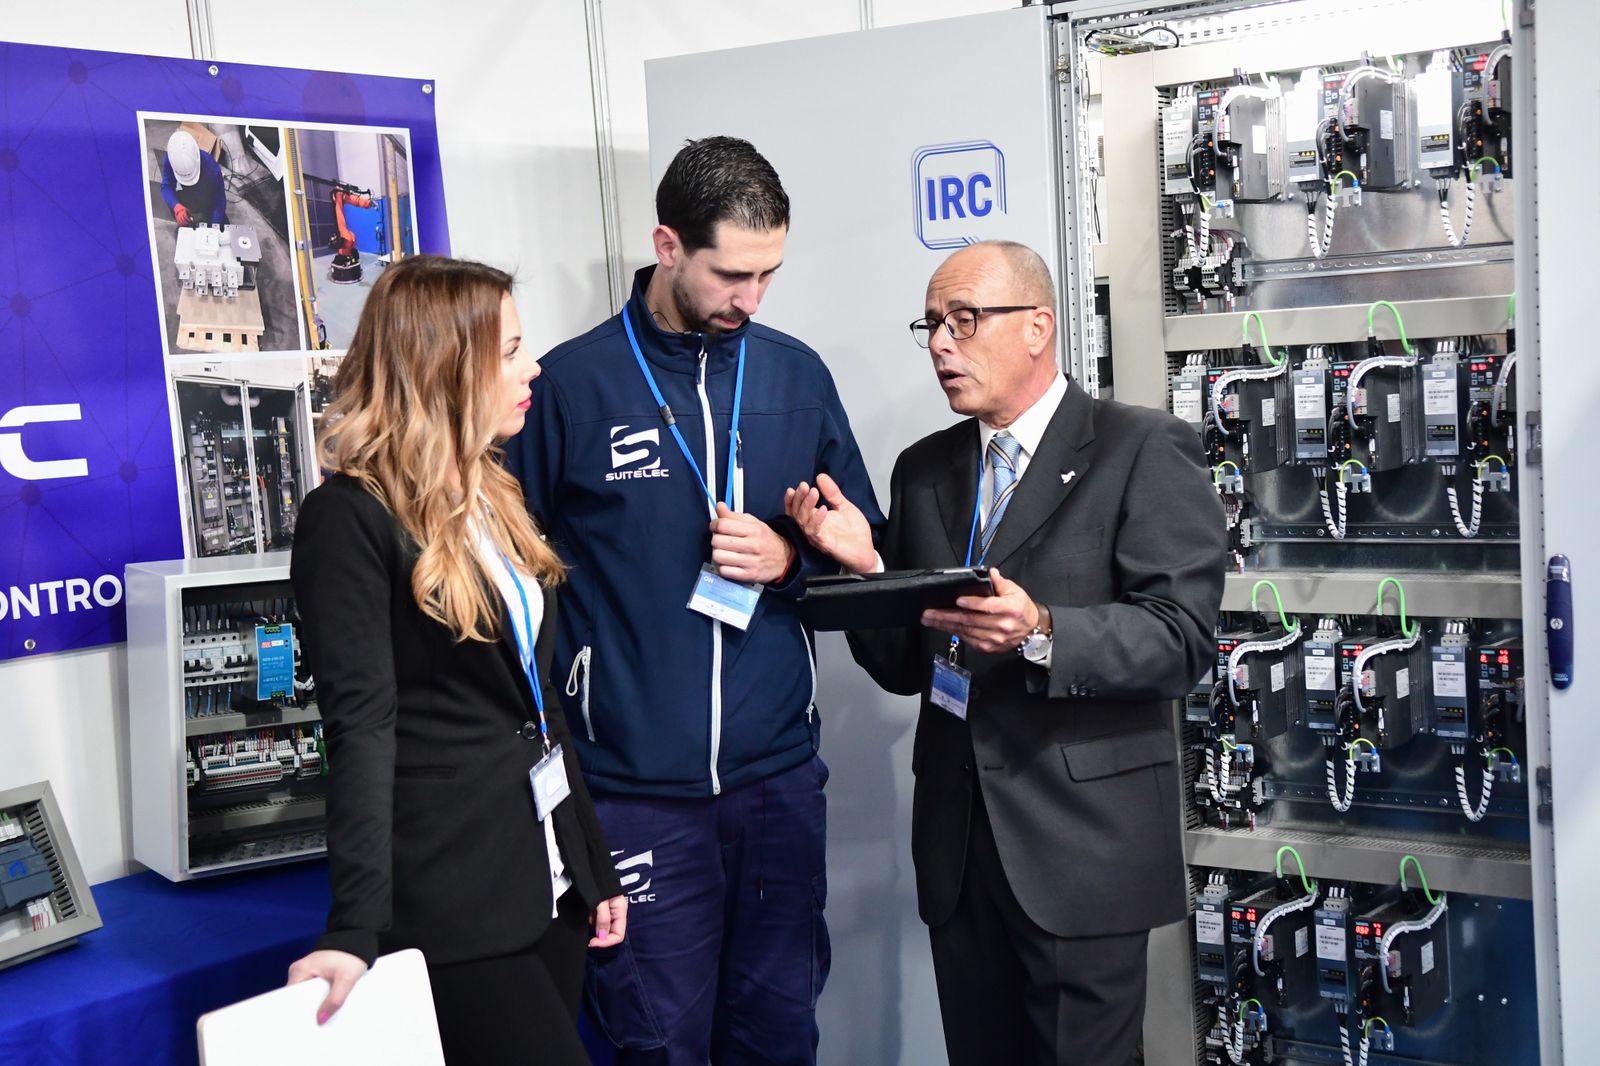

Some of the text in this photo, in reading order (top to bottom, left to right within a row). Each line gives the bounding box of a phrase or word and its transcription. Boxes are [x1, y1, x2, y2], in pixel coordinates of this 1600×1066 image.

[926, 174, 993, 221] IRC
[605, 469, 670, 481] SUITELEC
[0, 573, 123, 622] NTRO
